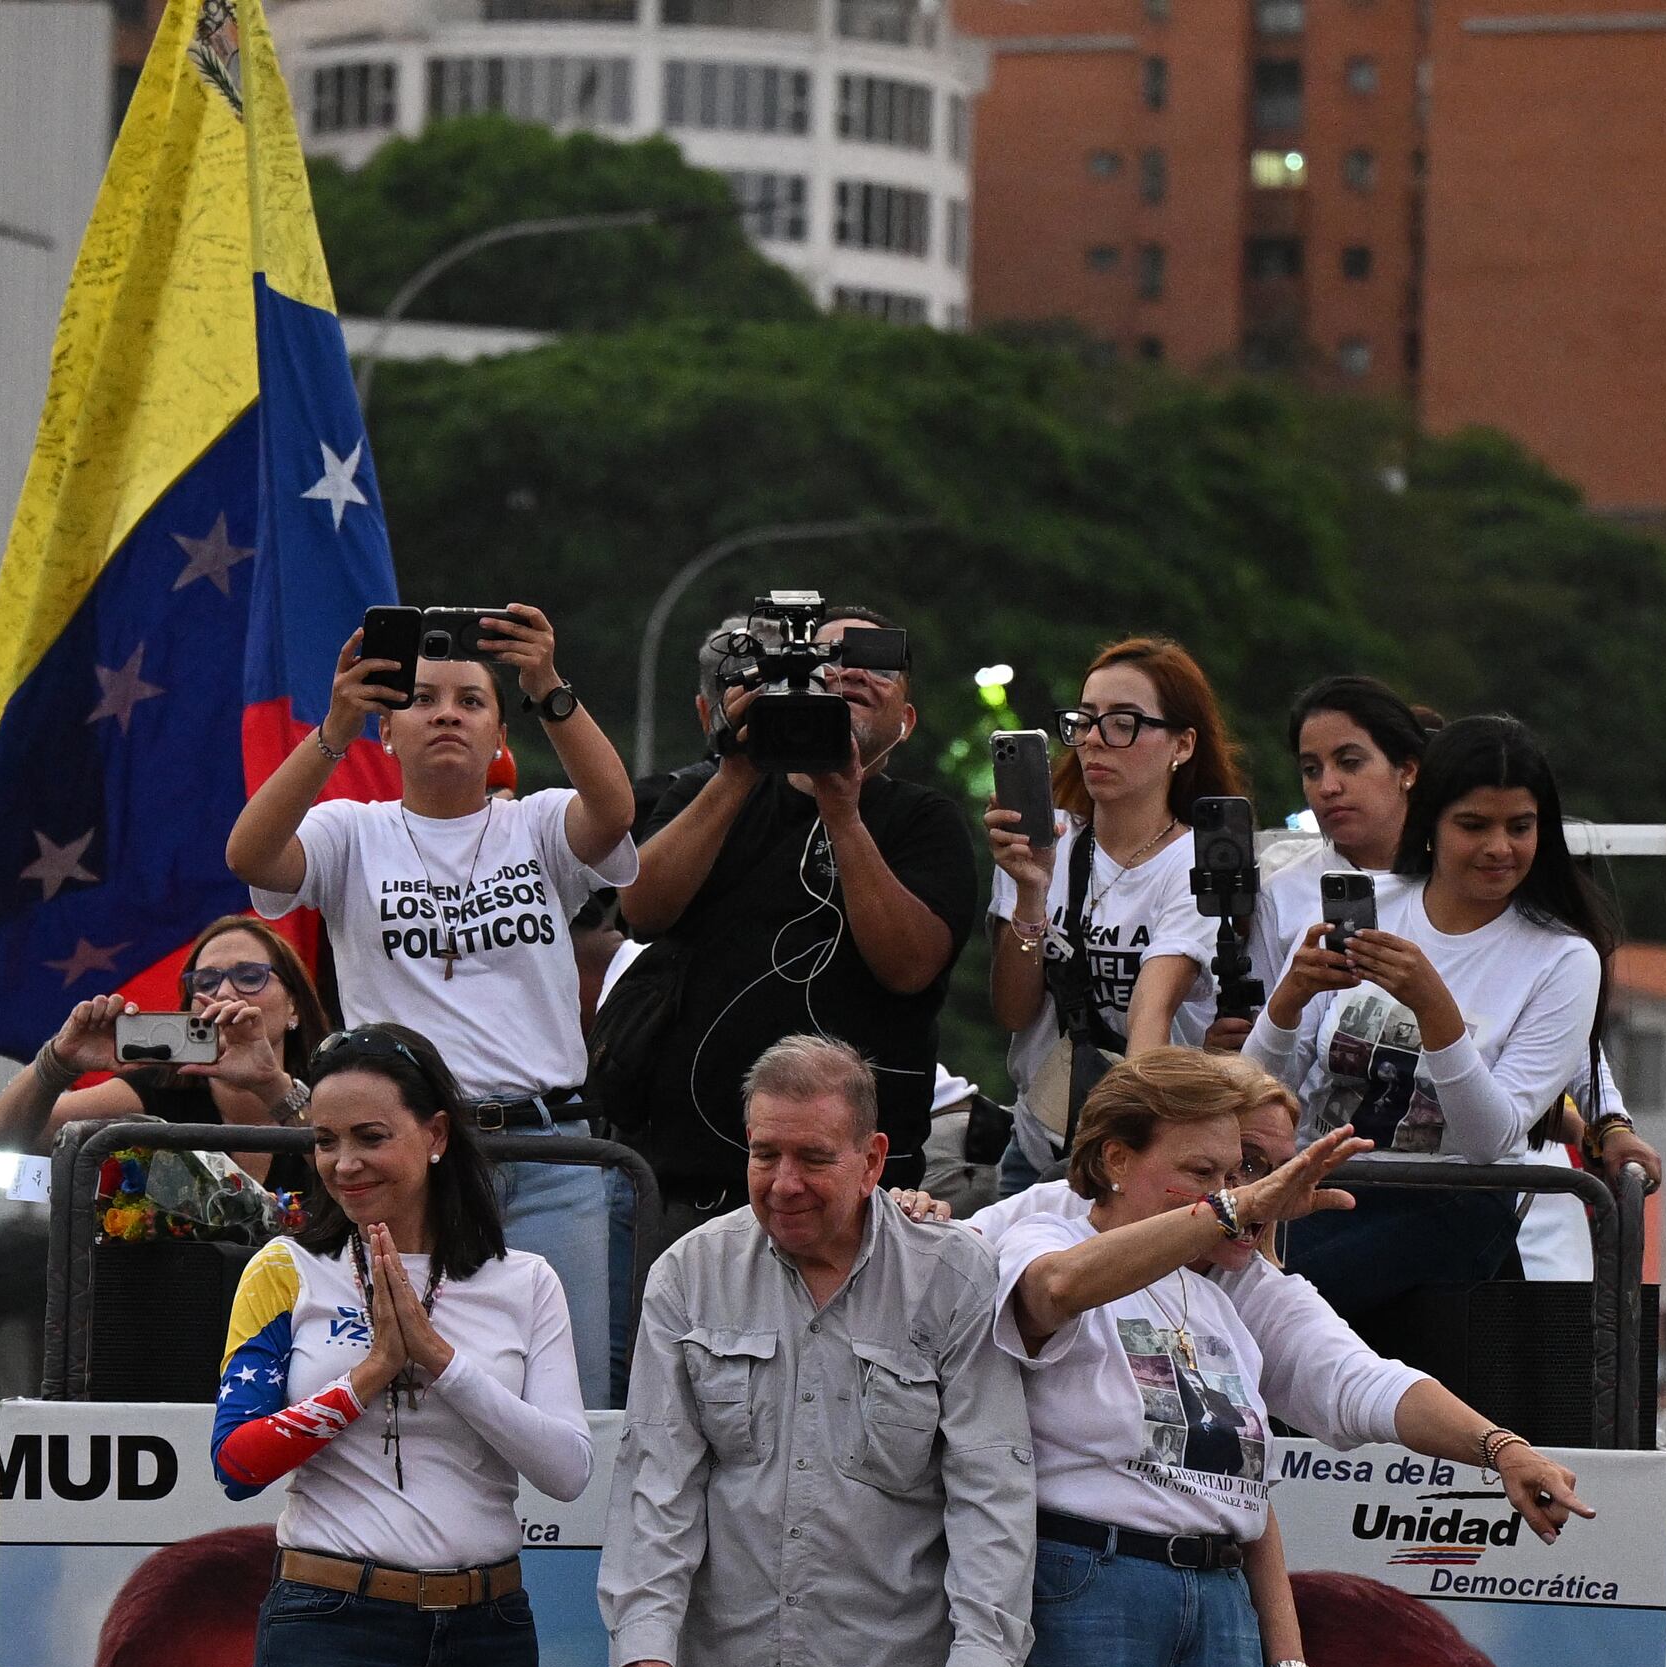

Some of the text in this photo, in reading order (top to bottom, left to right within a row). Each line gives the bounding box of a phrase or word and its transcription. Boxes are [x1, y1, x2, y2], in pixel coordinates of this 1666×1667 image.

[382, 860, 541, 901] LIBEREN A TODOS
[381, 881, 547, 924] LOS PRESOS
[382, 913, 555, 960] POLÍTICOS
[1129, 925, 1151, 947] A
[1125, 1458, 1269, 1500] THE LIBERTAD TOUR
[1281, 1451, 1455, 1486] Mesa de la
[1352, 1504, 1522, 1547] Unidad
[1430, 1568, 1619, 1600] Democrática
